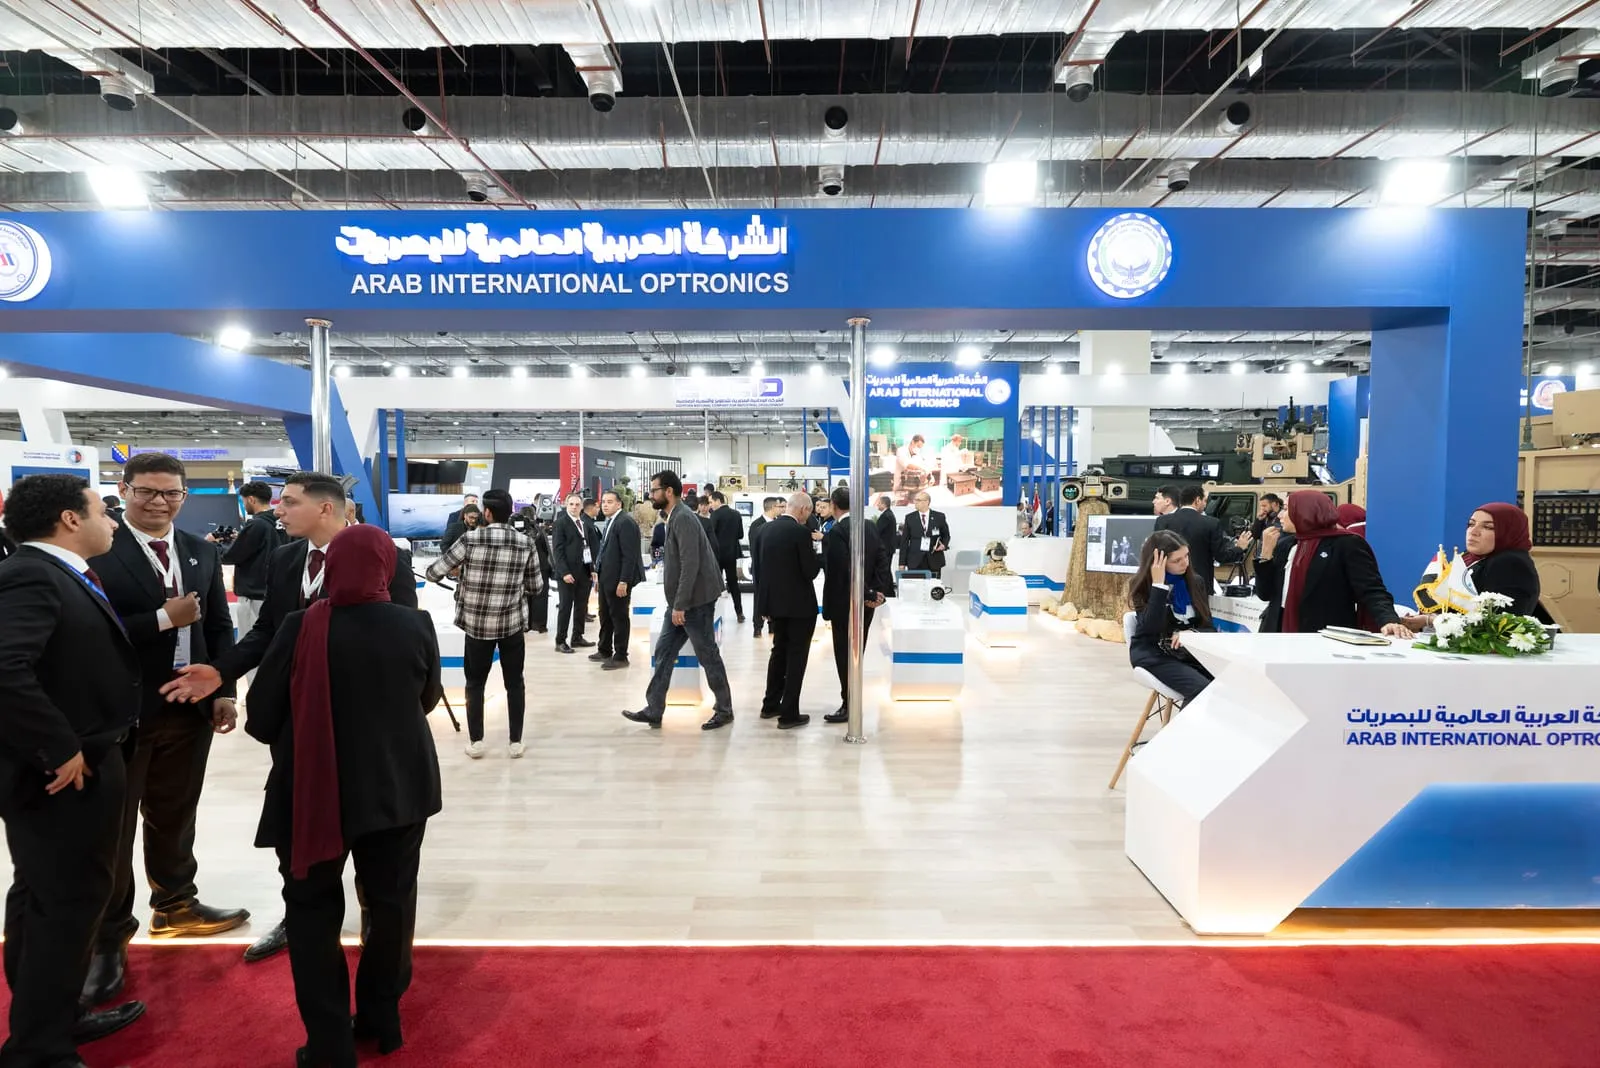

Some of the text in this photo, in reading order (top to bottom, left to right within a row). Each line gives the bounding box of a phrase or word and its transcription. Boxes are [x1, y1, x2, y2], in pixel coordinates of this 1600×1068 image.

[466, 222, 583, 263] العالمية
[583, 222, 682, 263] العربية
[682, 214, 787, 259] الشركة
[352, 273, 789, 294] ARAB INTERNATIONAL OPTRONICS
[869, 387, 984, 398] ARAB INTERNATIONAL
[900, 398, 960, 408] OPTRONICS
[1346, 708, 1431, 728] للبصريات
[1434, 705, 1511, 728] العالمية
[1514, 705, 1579, 728] العربية
[1346, 732, 1396, 746] ARAB
[1402, 732, 1542, 747] INTERNATIONAL
